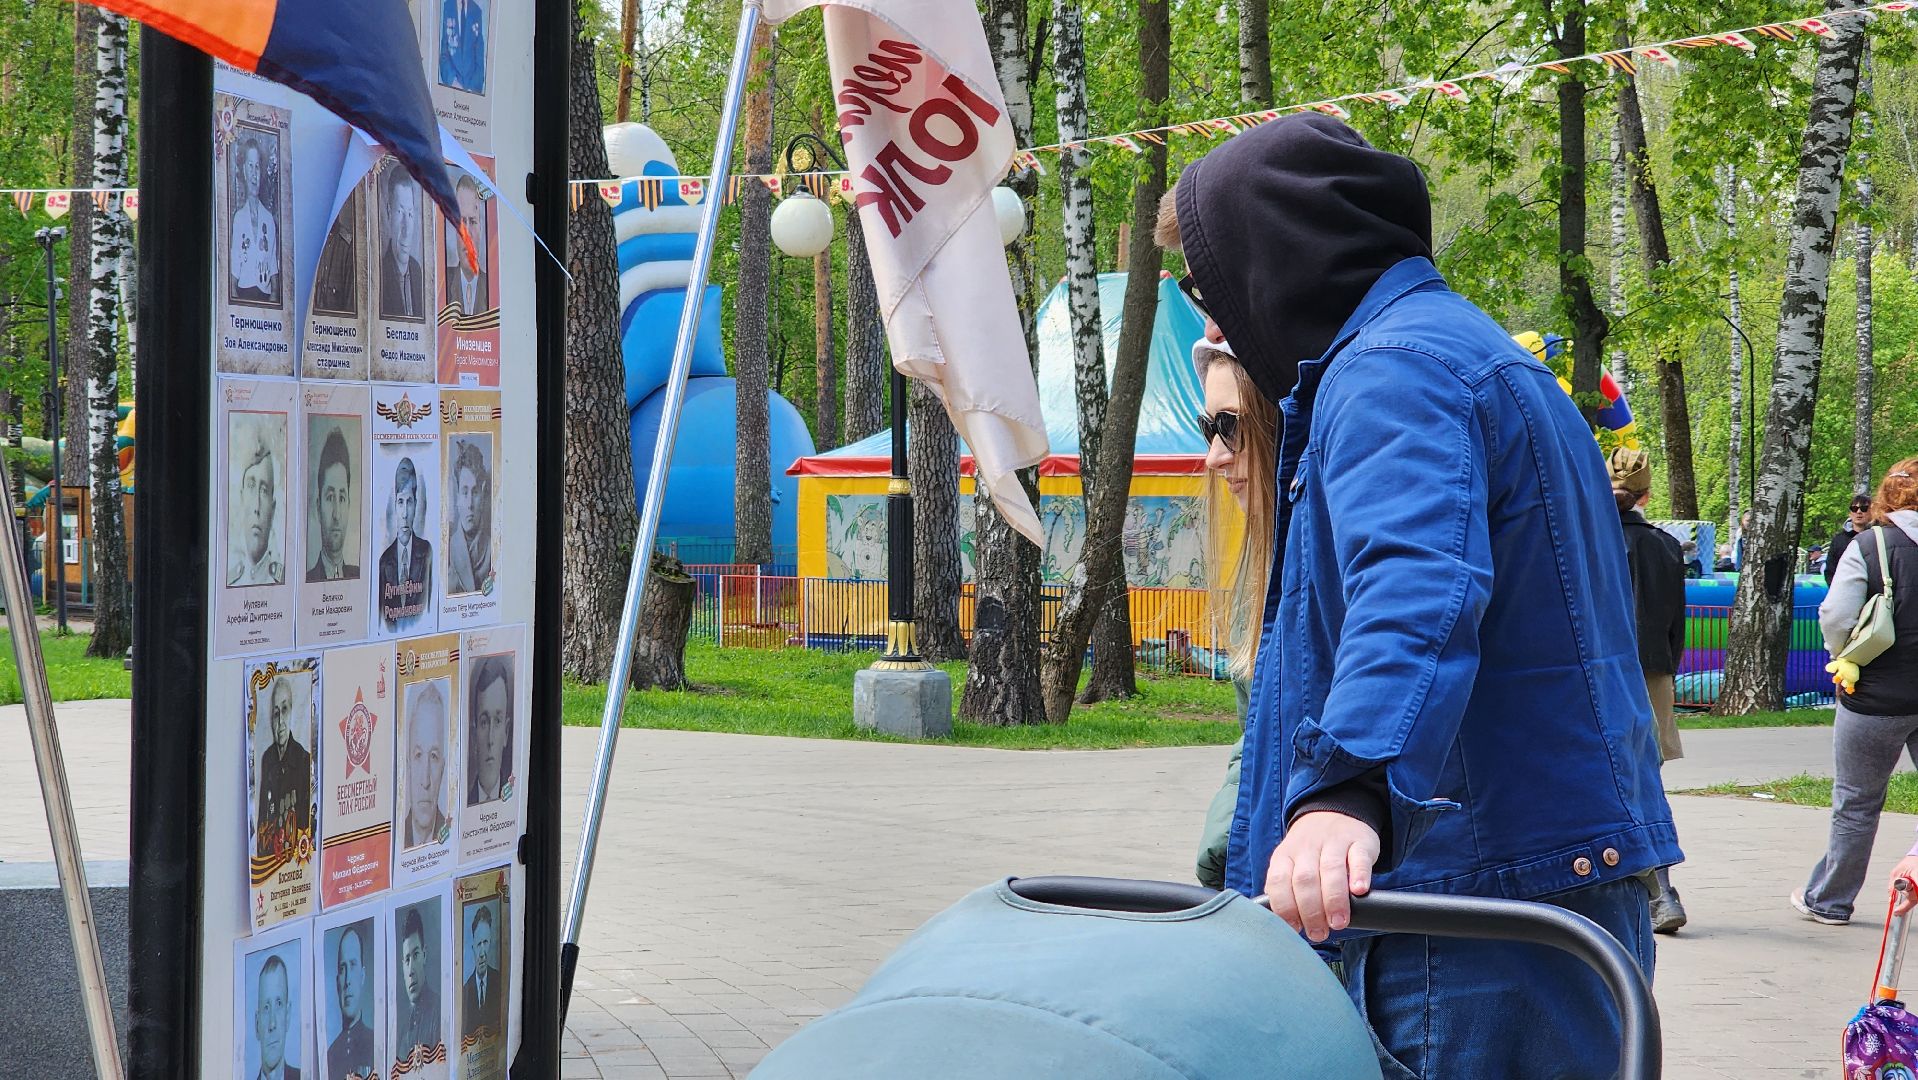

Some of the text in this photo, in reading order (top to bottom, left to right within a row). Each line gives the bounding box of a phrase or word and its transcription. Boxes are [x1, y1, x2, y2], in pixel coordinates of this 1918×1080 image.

[230, 314, 282, 332] Тернющенко
[312, 320, 357, 338] Тернющенко
[385, 326, 419, 341] Беспалов
[224, 336, 288, 354] Зоя Александровна
[306, 341, 331, 354] Александр
[456, 336, 492, 352] Иноземцев
[317, 358, 351, 369] старшина
[399, 349, 426, 362] Иванович
[249, 611, 283, 624] Дмитриевич
[337, 774, 377, 801] БЕССМЕРТНЫЙ
[338, 794, 376, 817] ПОЛК РОССИИ
